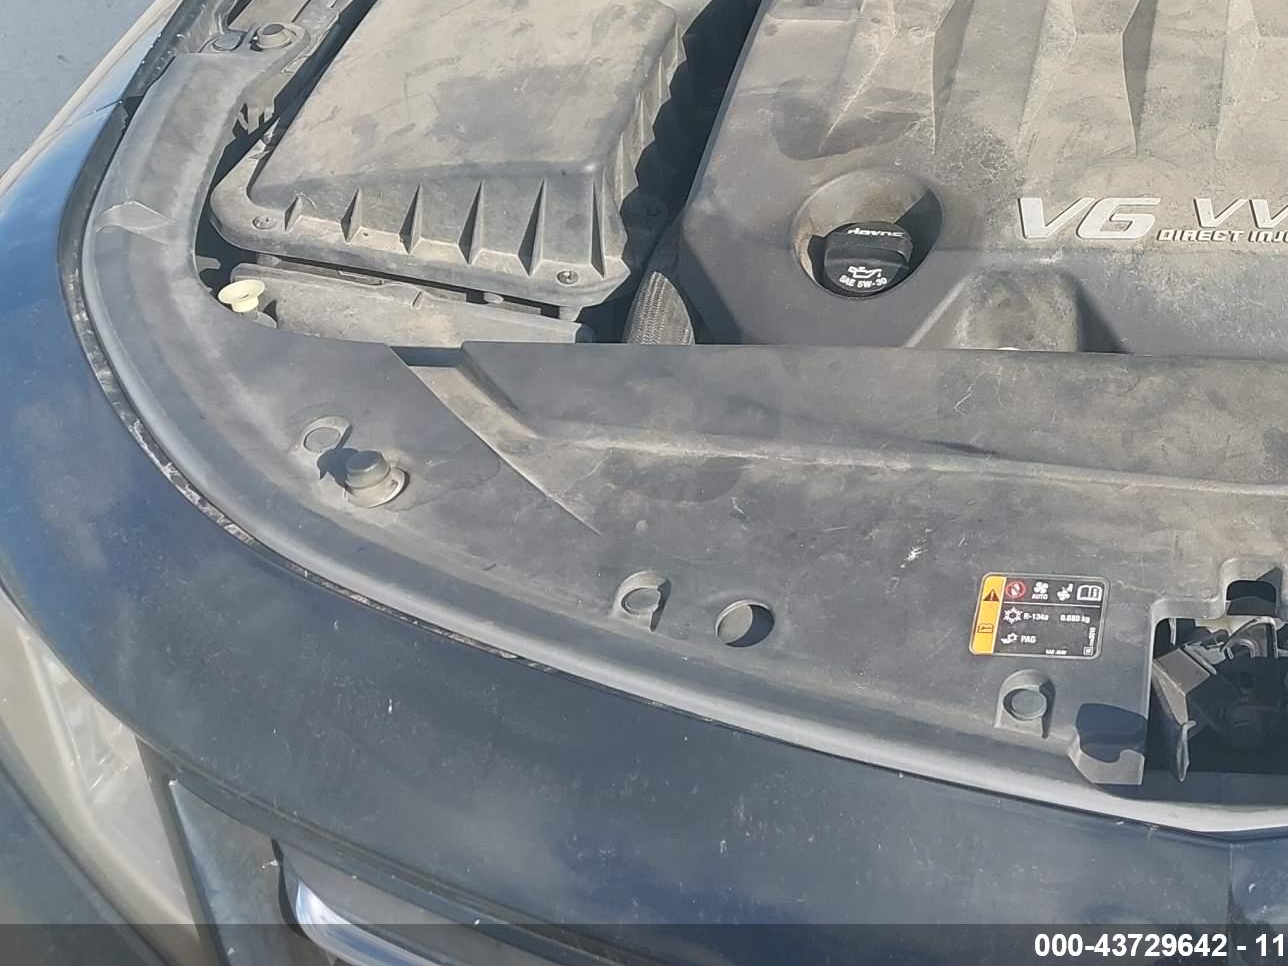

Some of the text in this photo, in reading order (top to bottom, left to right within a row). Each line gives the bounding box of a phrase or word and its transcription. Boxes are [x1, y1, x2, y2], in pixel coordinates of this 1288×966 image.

[1018, 196, 1161, 240] V6
[1156, 228, 1243, 244] DIRECT
[839, 274, 888, 288] SAE 5W-30
[1031, 593, 1049, 601] AUTO
[1021, 635, 1037, 644] PAG
